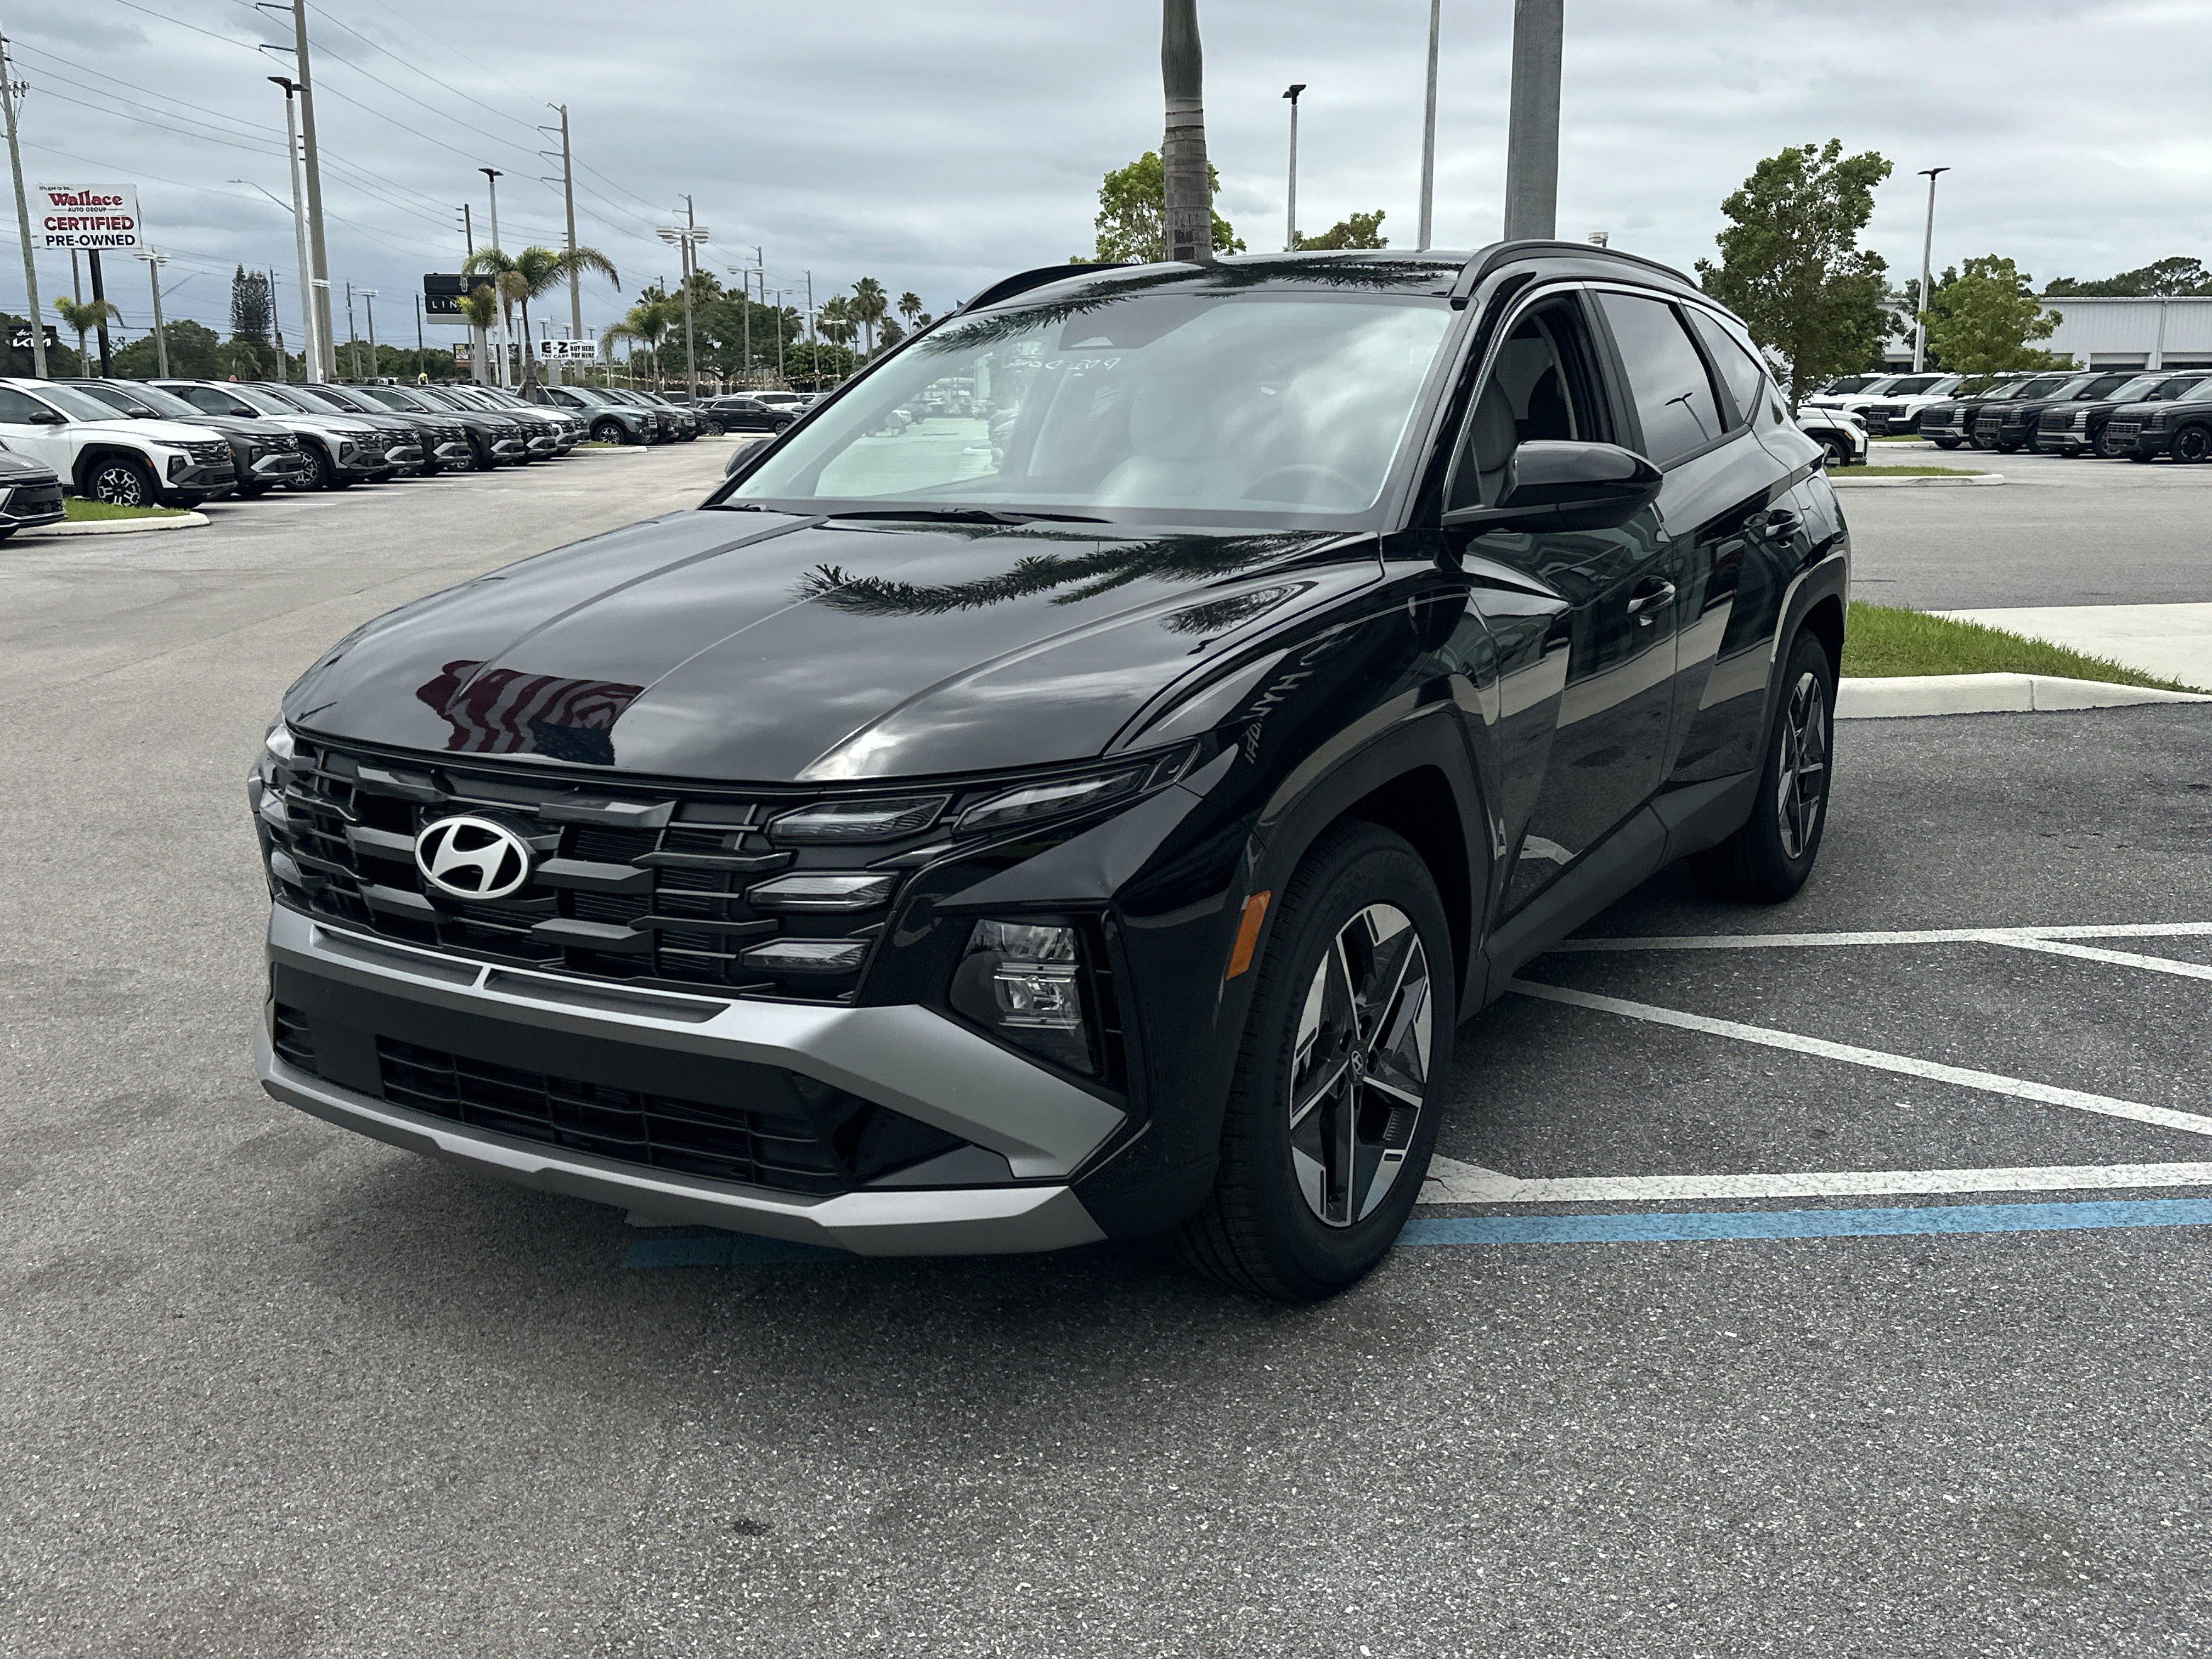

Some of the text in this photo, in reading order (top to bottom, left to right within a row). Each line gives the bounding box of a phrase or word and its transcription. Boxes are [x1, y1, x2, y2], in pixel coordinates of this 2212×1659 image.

[48, 190, 123, 206] Wallace
[44, 217, 134, 230] CERTIFIED
[46, 234, 135, 246] PRE-OWNED
[541, 341, 568, 354] E-Z
